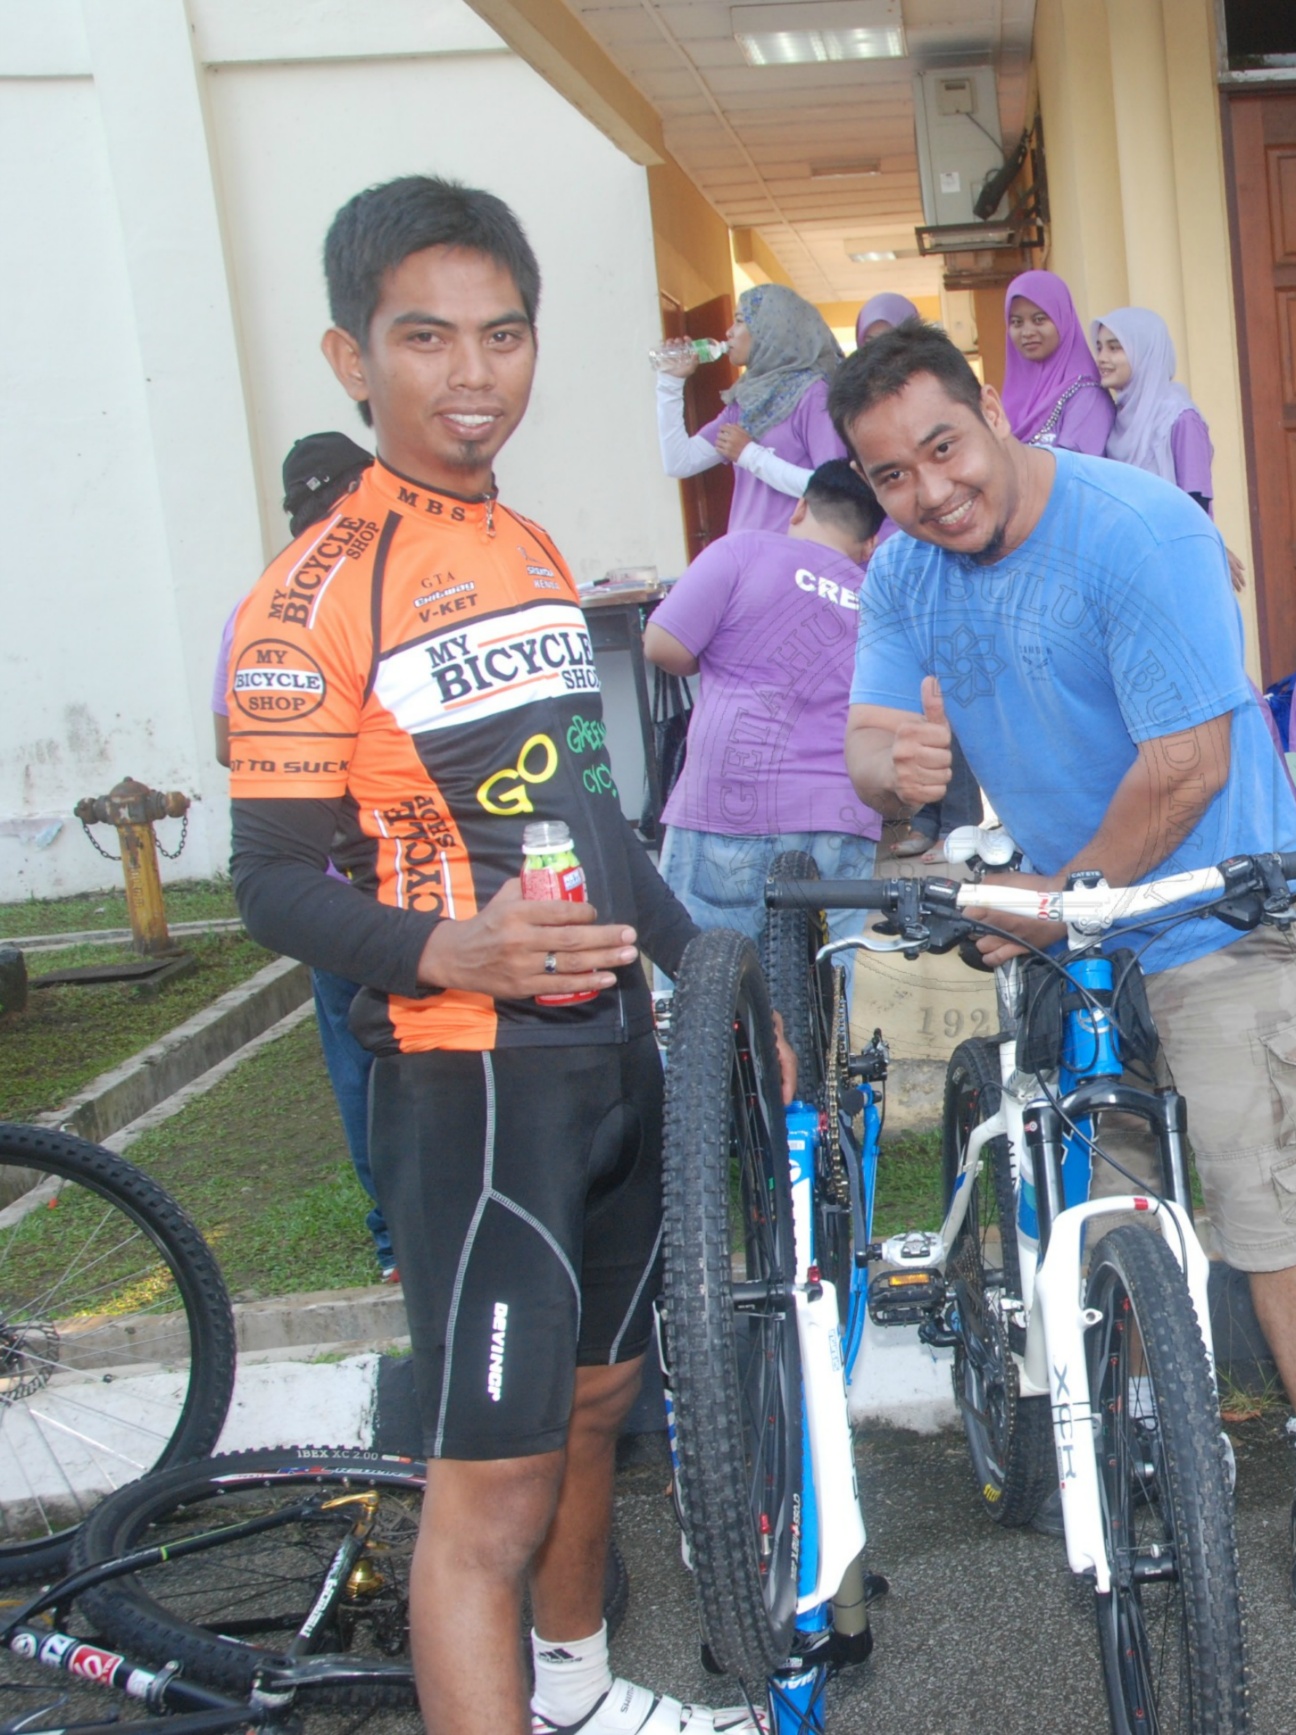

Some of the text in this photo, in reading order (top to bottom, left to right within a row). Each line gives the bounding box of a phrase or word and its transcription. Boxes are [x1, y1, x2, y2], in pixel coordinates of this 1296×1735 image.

[346, 521, 380, 560] SHOP
[282, 516, 366, 628] BICYCLE
[421, 571, 456, 589] GTA
[268, 588, 287, 620] MY
[795, 568, 861, 611] CRE
[419, 593, 479, 623] V-KET
[256, 649, 288, 664] MY
[425, 633, 472, 669] MY
[236, 671, 321, 690] BICYCLE
[431, 631, 595, 704] BICYCLE
[248, 696, 306, 711] SHOP
[248, 759, 276, 773] TO
[283, 760, 351, 774] SUCK
[476, 733, 558, 816] GO
[414, 795, 457, 848] SHOP
[297, 1450, 379, 1461] IBEX XC 2.00
